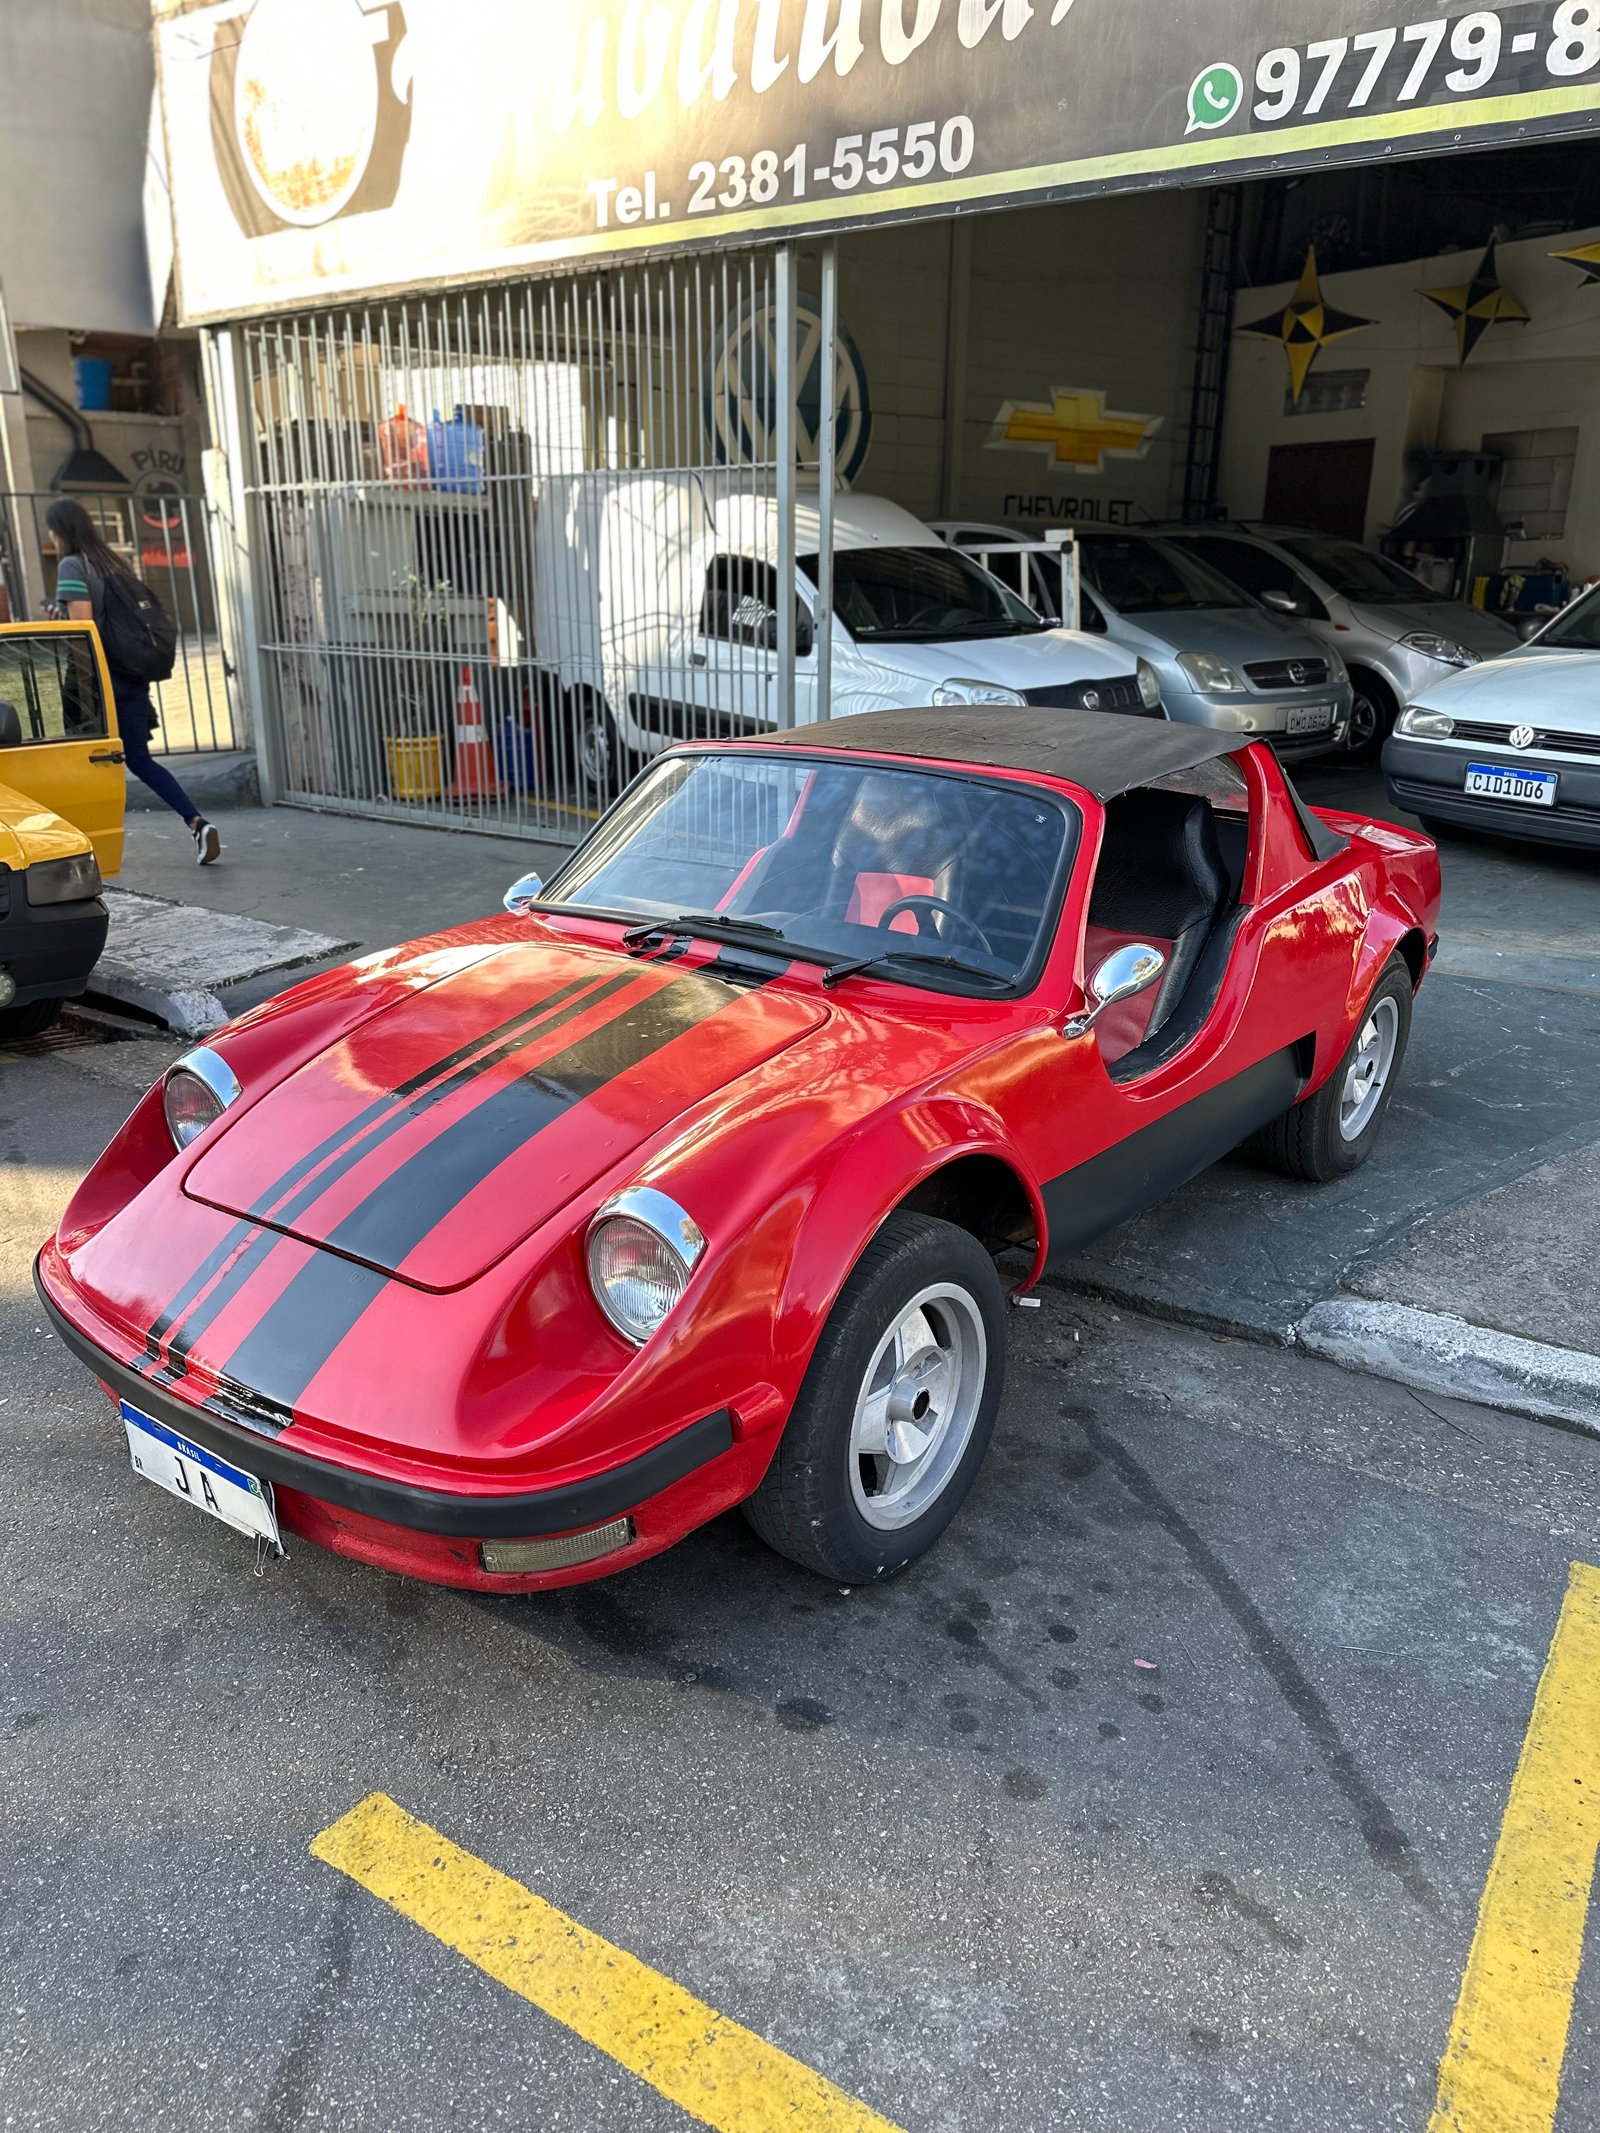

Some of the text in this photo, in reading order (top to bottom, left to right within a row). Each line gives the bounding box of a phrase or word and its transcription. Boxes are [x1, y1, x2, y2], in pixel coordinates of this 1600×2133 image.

[587, 115, 975, 228] Tel. 2381-5550
[1003, 494, 1134, 525] CHEVROLET
[1472, 774, 1544, 800] CID1D06
[177, 1440, 202, 1461] BRASIL
